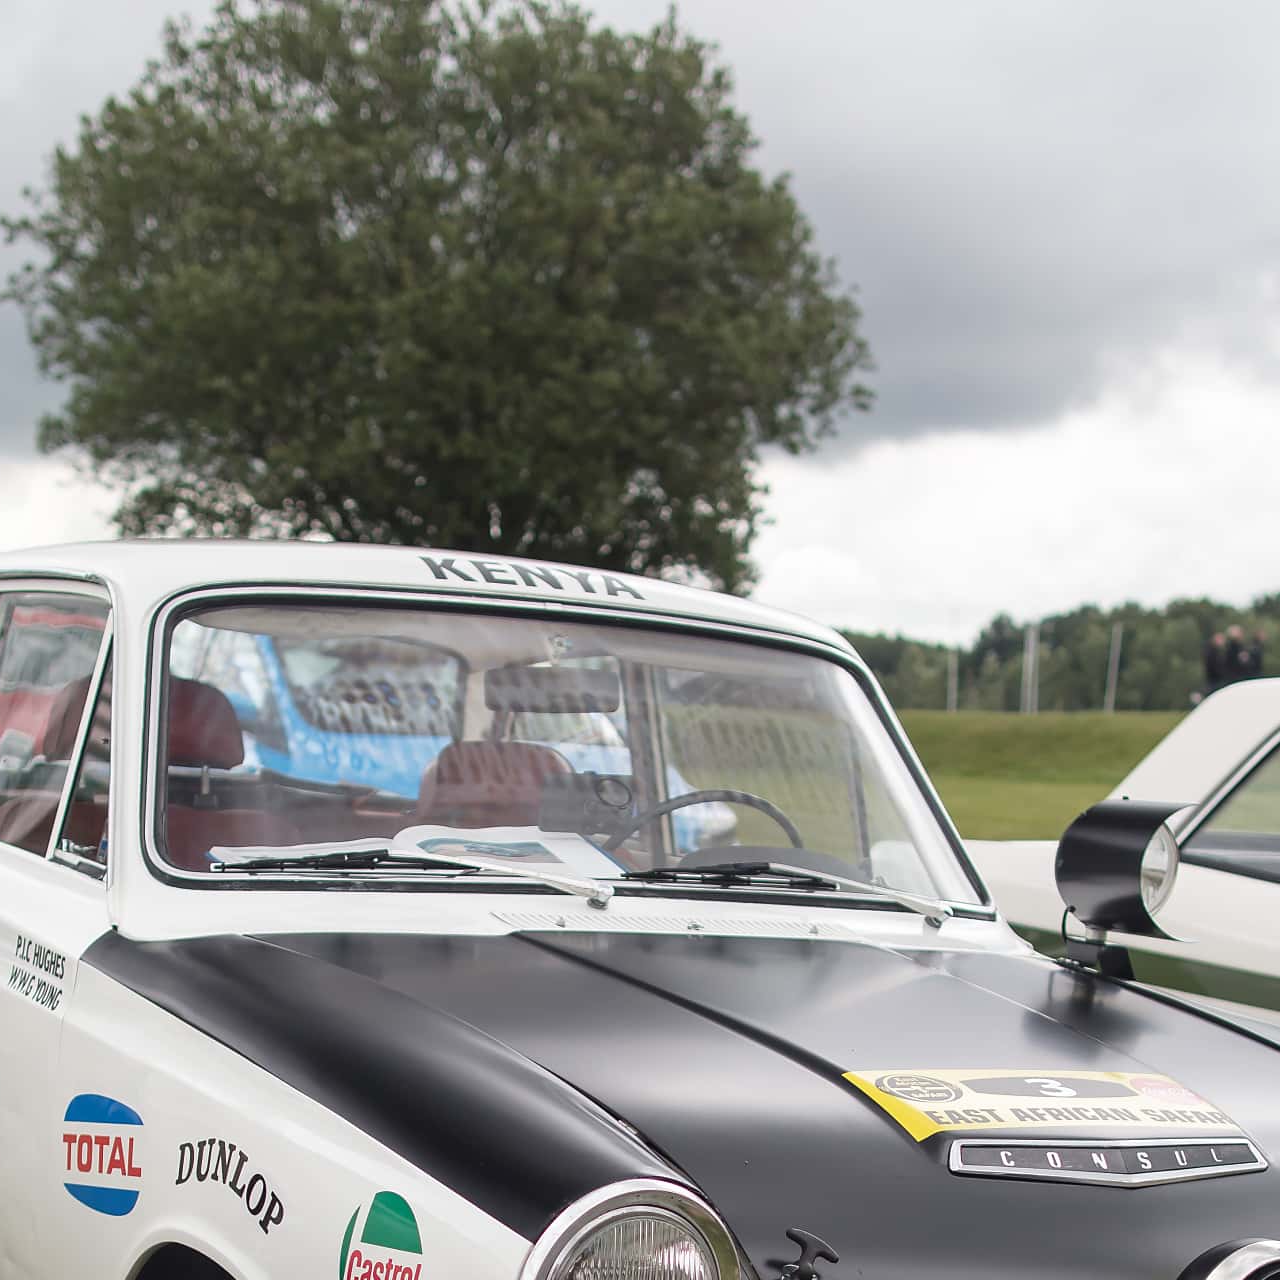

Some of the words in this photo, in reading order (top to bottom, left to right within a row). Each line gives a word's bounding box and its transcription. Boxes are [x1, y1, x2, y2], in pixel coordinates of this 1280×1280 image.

[419, 556, 645, 600] KENYA
[32, 943, 66, 980] HUGHES
[32, 978, 63, 1011] YOUNG
[1024, 1078, 1077, 1098] 3
[925, 1108, 1005, 1125] EAST
[1009, 1107, 1141, 1122] AFRICAN
[62, 1133, 142, 1178] TOTAL
[1000, 1149, 1223, 1170] CONSUL
[175, 1138, 285, 1234] DUNLOP
